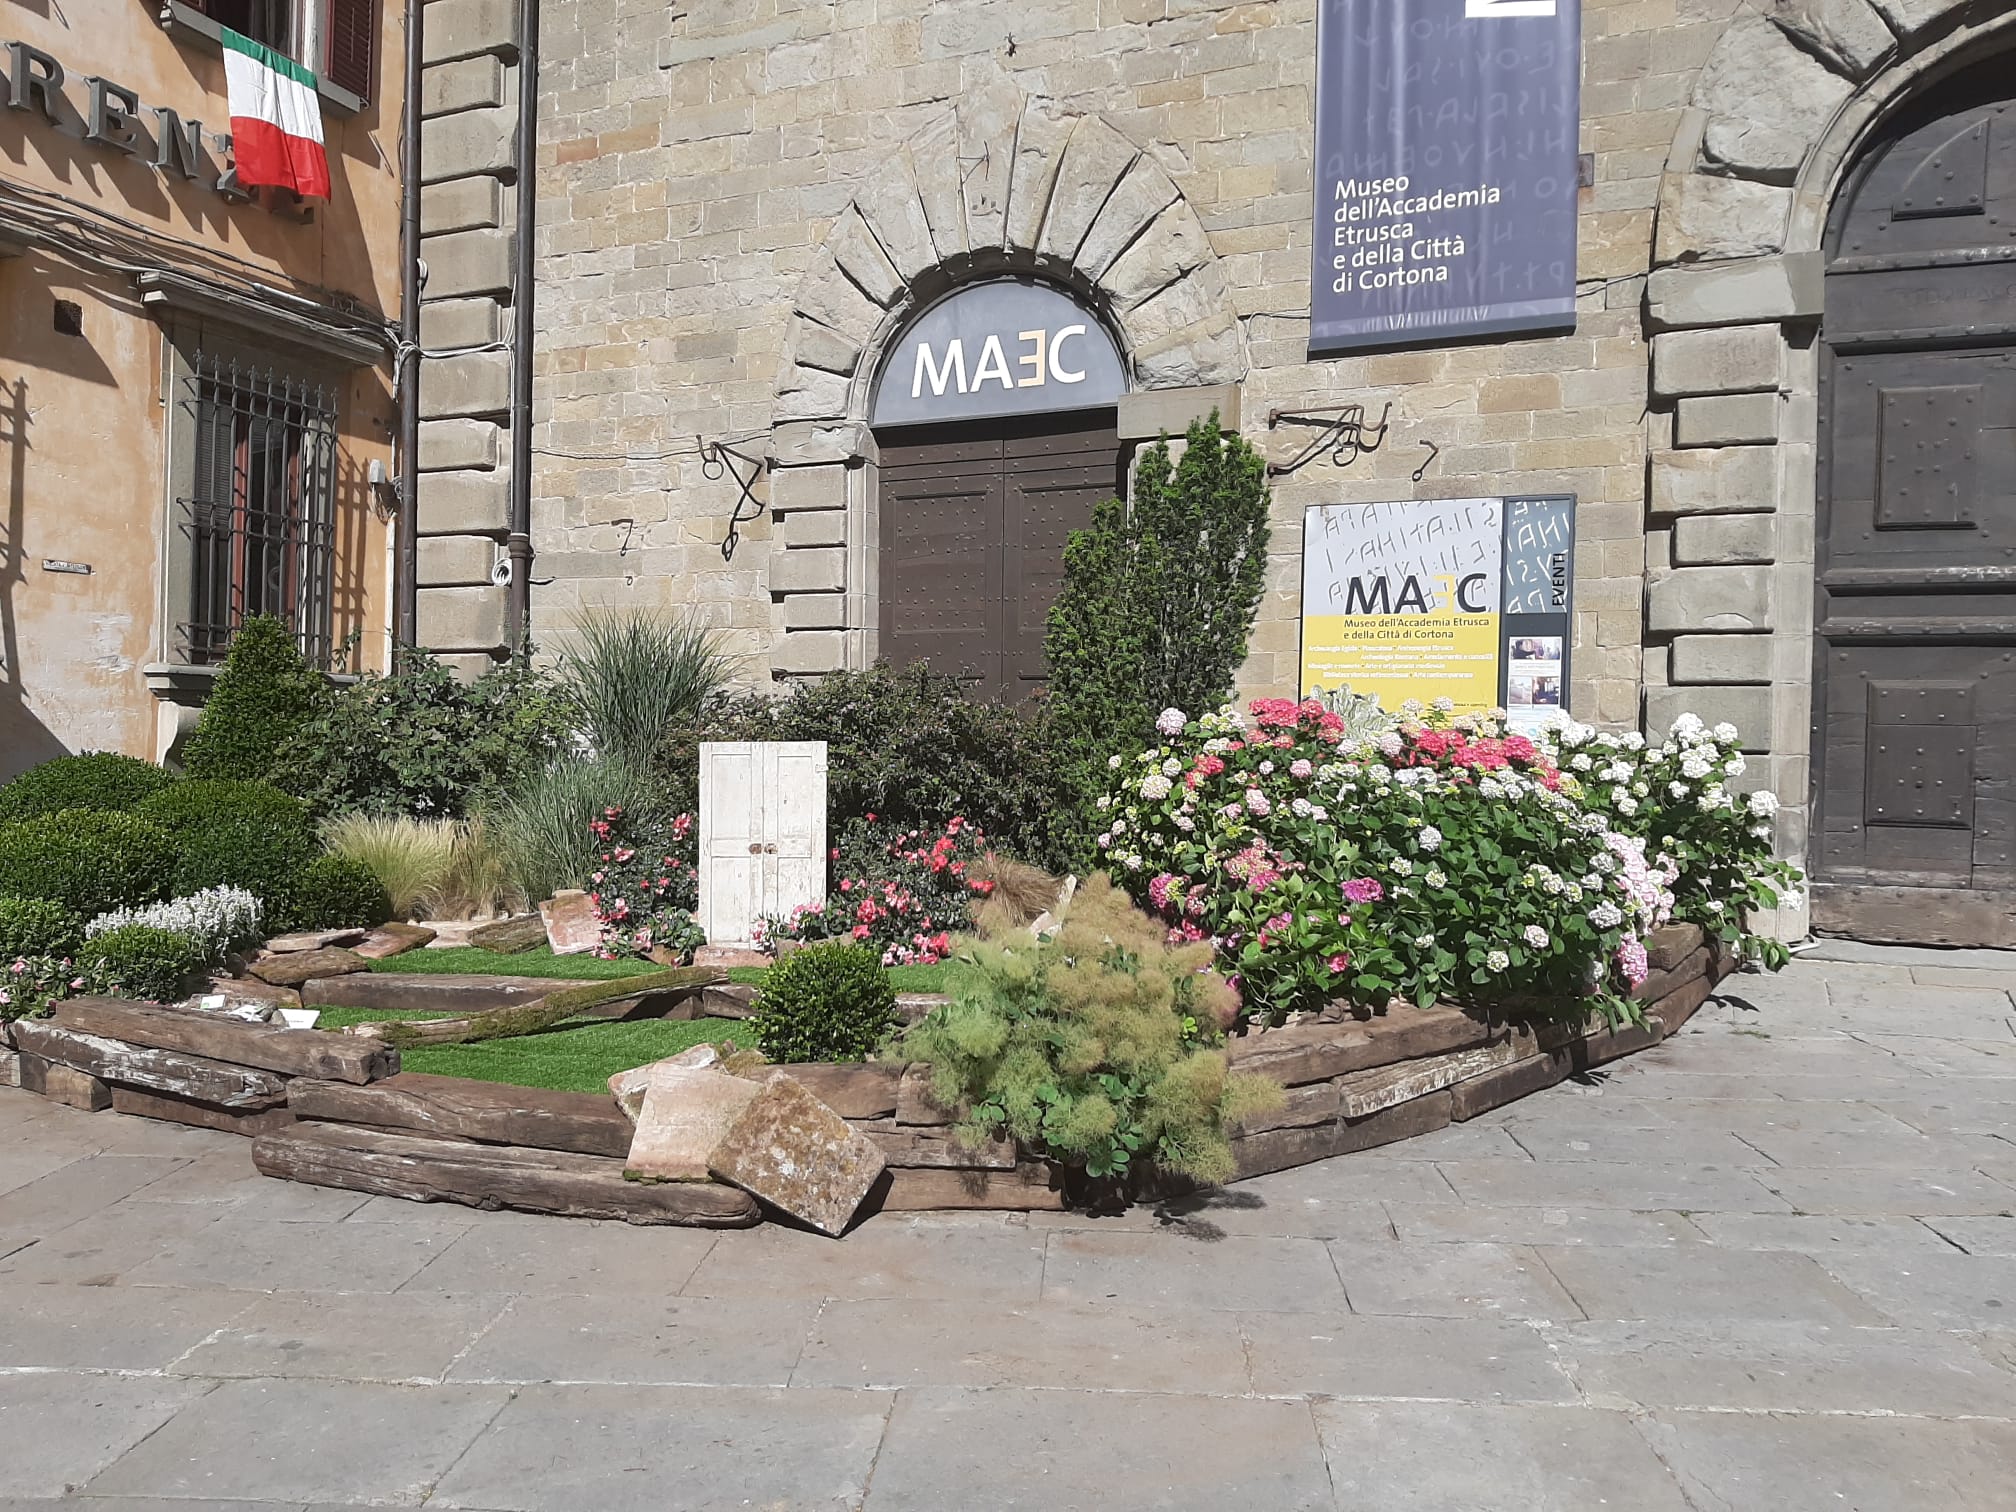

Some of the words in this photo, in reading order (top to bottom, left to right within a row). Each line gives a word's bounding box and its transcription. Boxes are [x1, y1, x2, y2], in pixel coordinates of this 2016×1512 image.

[1334, 175, 1410, 200] Museo
[1334, 183, 1501, 223] dell'Accademia
[1334, 221, 1414, 247] Etrusca
[1333, 254, 1346, 269] e
[1351, 243, 1404, 268] della
[1410, 234, 1465, 260] Città
[1332, 272, 1353, 293] di
[1359, 265, 1448, 290] Cortona
[1552, 553, 1566, 606] EVENTI
[1344, 619, 1377, 628] Museo
[1378, 617, 1451, 628] dell'Accademia
[1453, 618, 1490, 627] Etrusca
[1351, 630, 1375, 640] della
[1376, 630, 1400, 640] Città
[1402, 630, 1412, 639] di
[1414, 630, 1454, 639] Cortona
